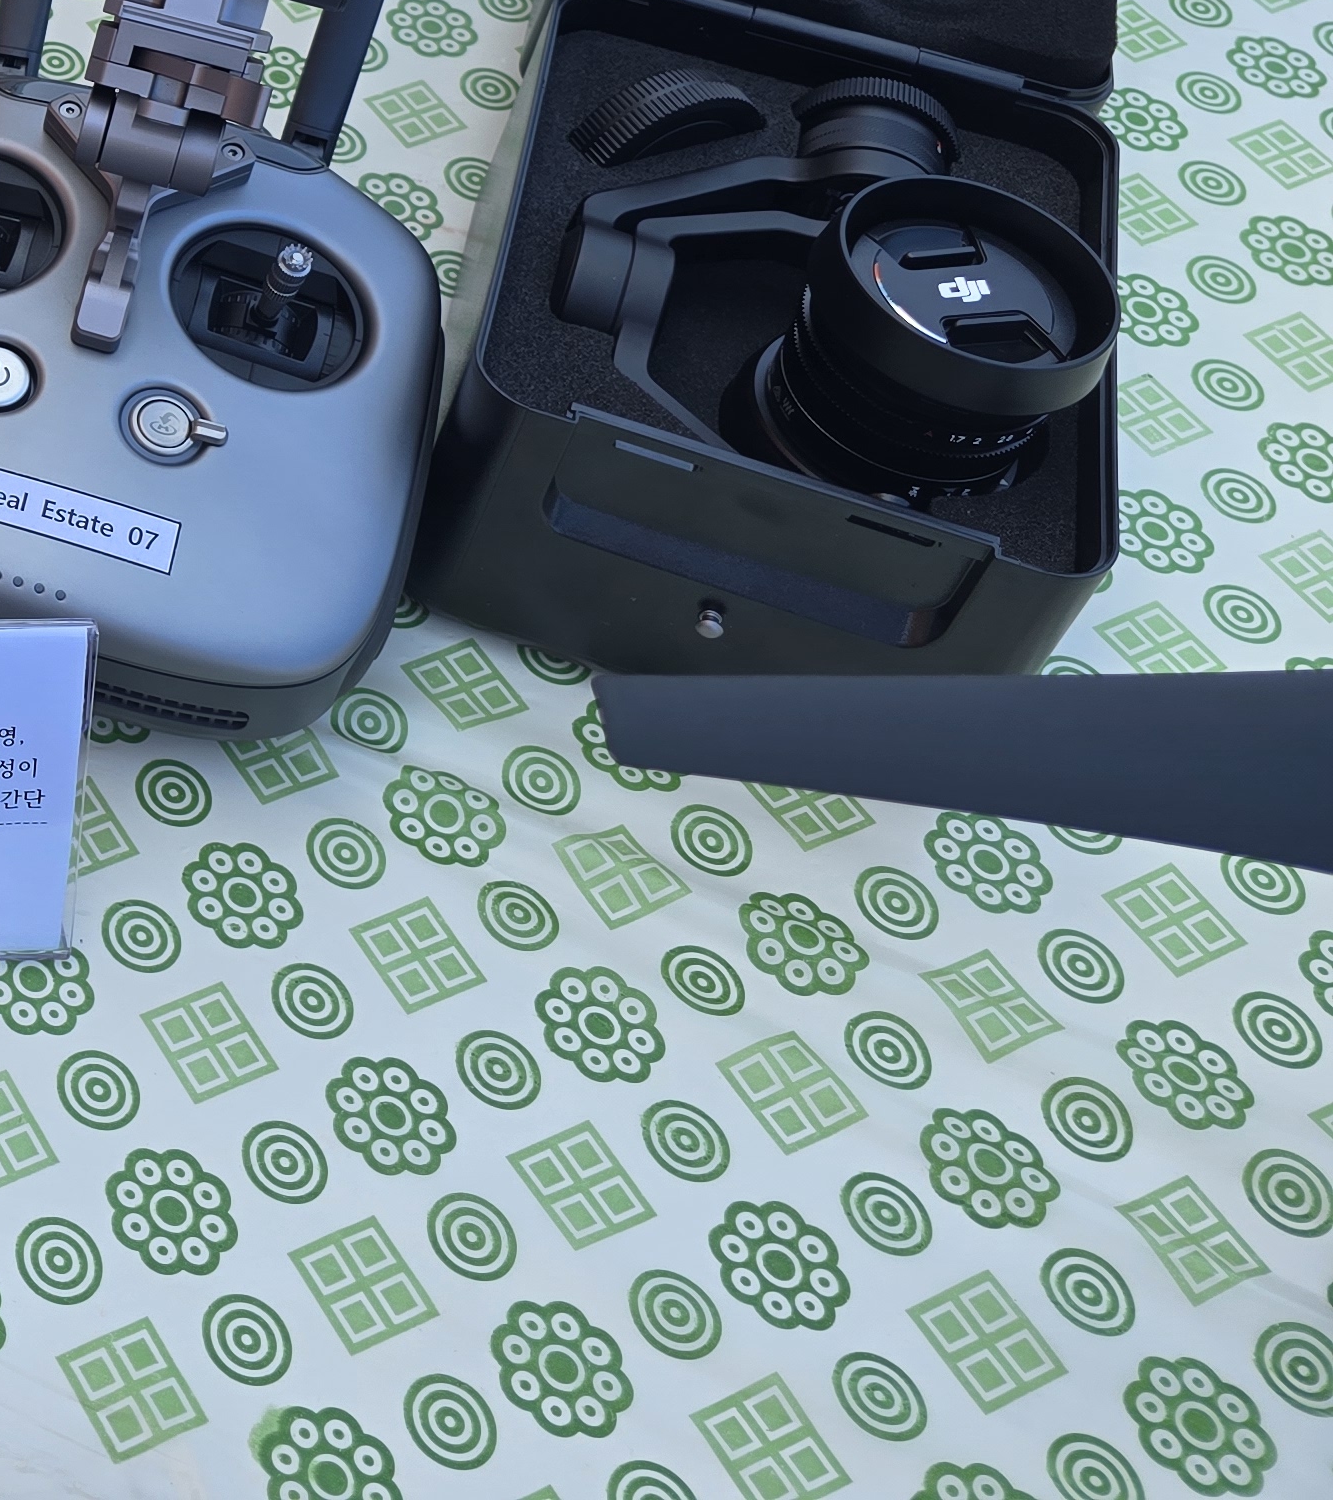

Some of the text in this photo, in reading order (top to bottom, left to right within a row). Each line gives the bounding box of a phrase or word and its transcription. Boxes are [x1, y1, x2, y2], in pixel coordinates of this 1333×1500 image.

[972, 436, 982, 444] 2
[41, 499, 114, 537] Estate
[128, 526, 160, 550] 07
[0, 788, 46, 810] 간단
